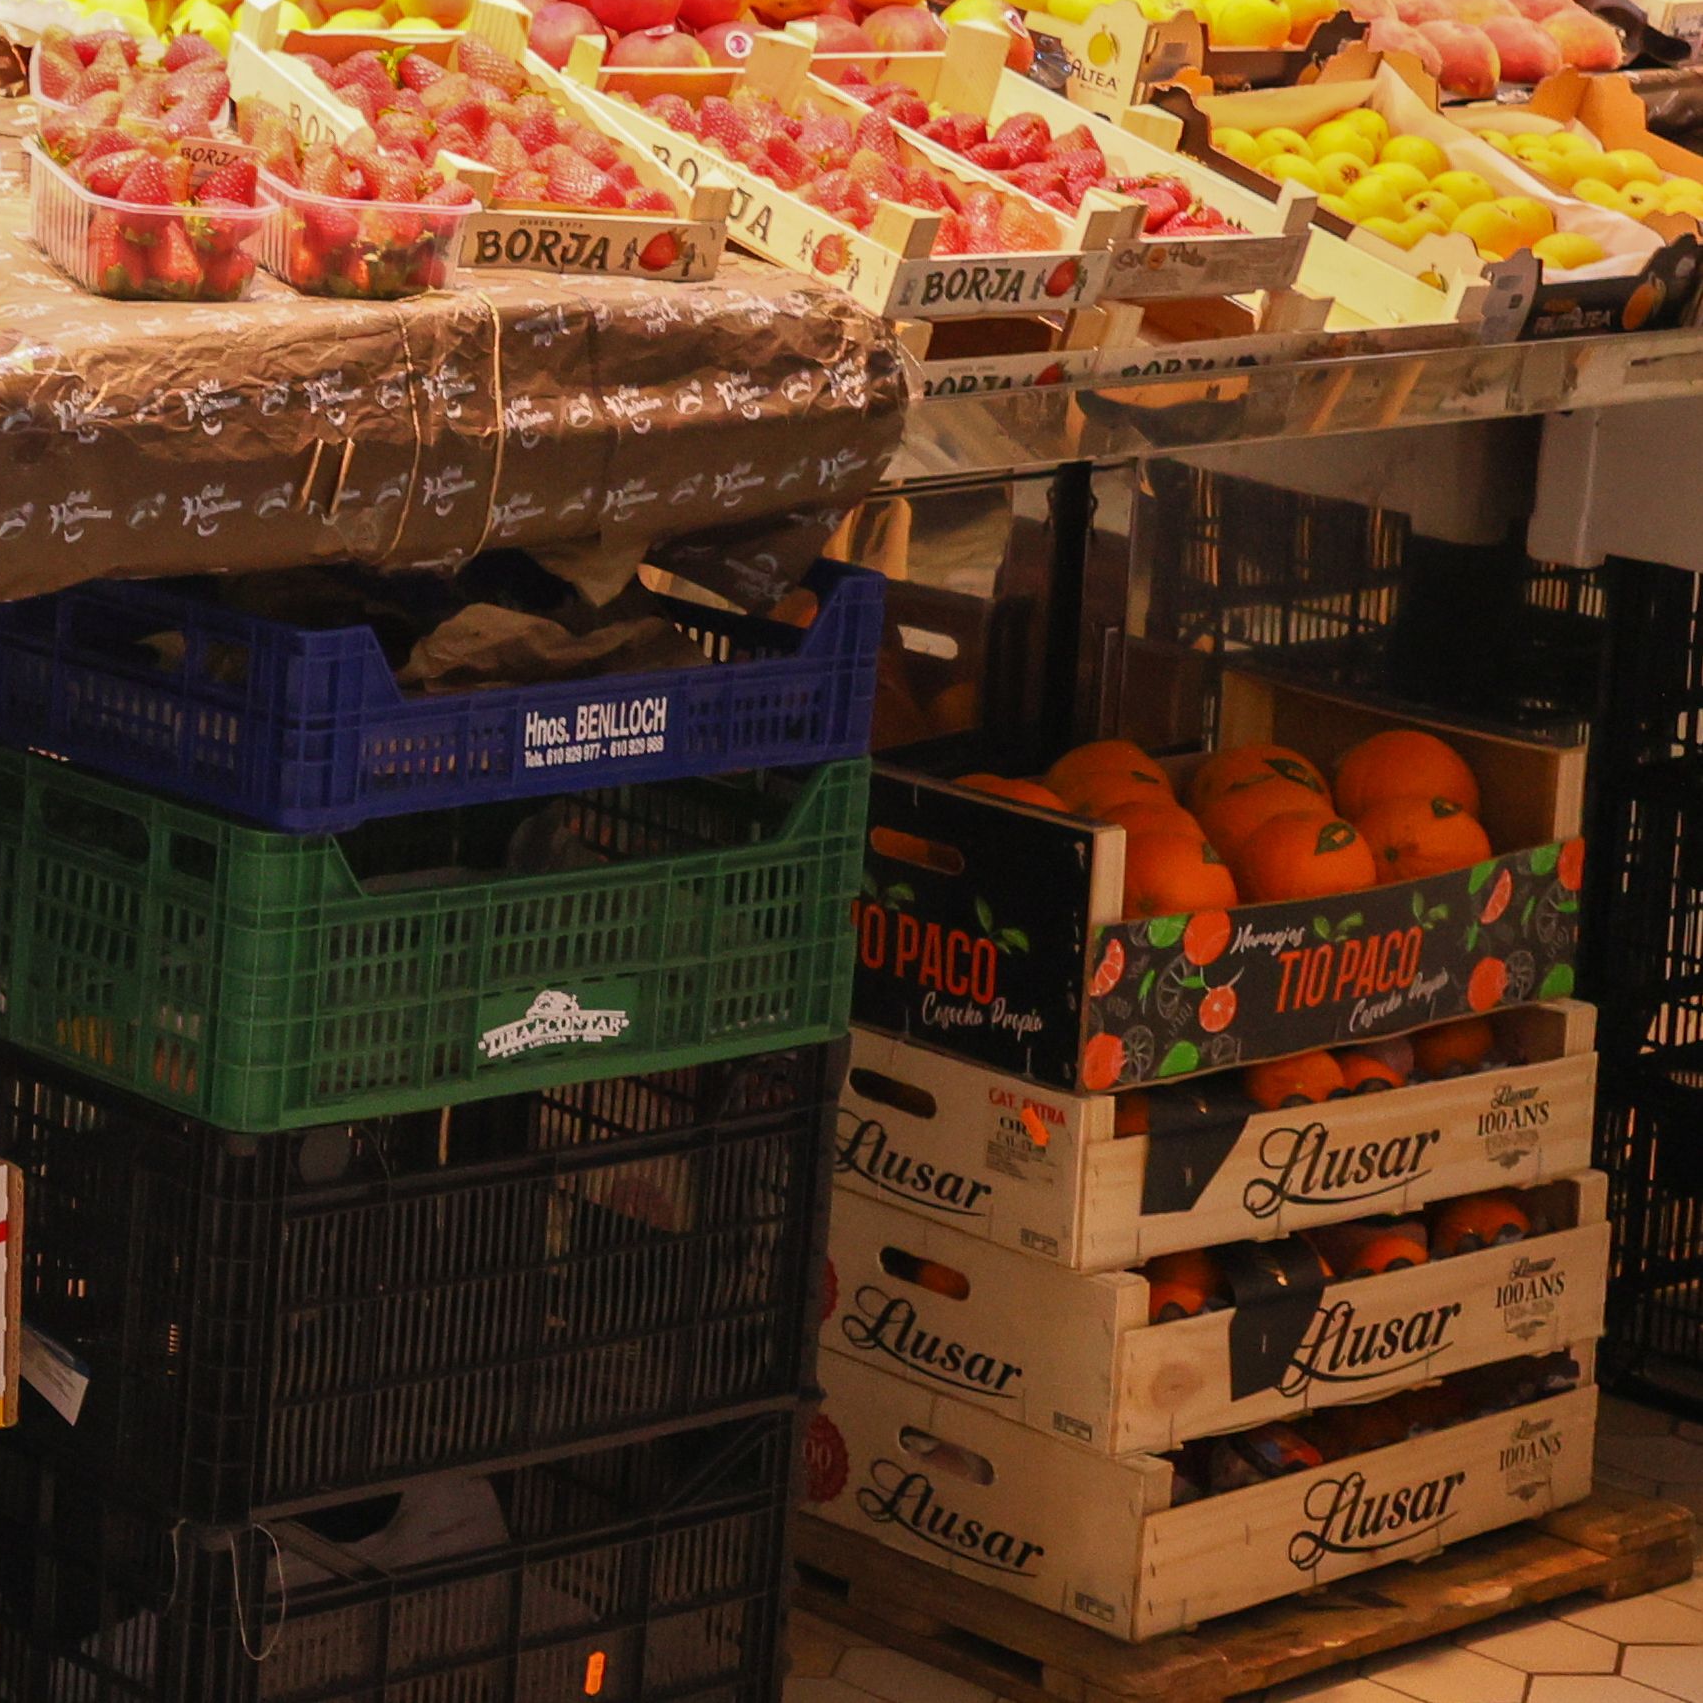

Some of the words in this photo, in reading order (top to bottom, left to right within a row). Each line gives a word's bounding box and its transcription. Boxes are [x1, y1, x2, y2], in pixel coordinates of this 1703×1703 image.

[651, 143, 771, 248] BOJA
[474, 229, 611, 272] BORJA
[923, 268, 1025, 307] BORJA
[524, 711, 570, 747] Hnos.
[575, 696, 668, 742] BENLLOCH
[895, 912, 997, 1005] PACO
[1277, 948, 1334, 1013] TIO
[1336, 926, 1424, 998] PACO
[486, 1025, 535, 1054] TIRA
[543, 1016, 621, 1036] CONTAR
[922, 991, 984, 1027] Cosecha
[991, 996, 1043, 1041] Propia
[1347, 994, 1402, 1034] Cosecha
[1477, 1107, 1507, 1136] 100
[1509, 1100, 1550, 1130] ANS
[833, 1110, 992, 1218] Llusar
[1243, 1122, 1441, 1219] Llusar
[1496, 1283, 1524, 1308] 100
[1525, 1271, 1565, 1301] ANS
[843, 1285, 1023, 1399] Llusar
[1289, 1300, 1462, 1393] Llusar
[861, 1459, 1045, 1579] Llusar
[1288, 1471, 1465, 1570] Llusar
